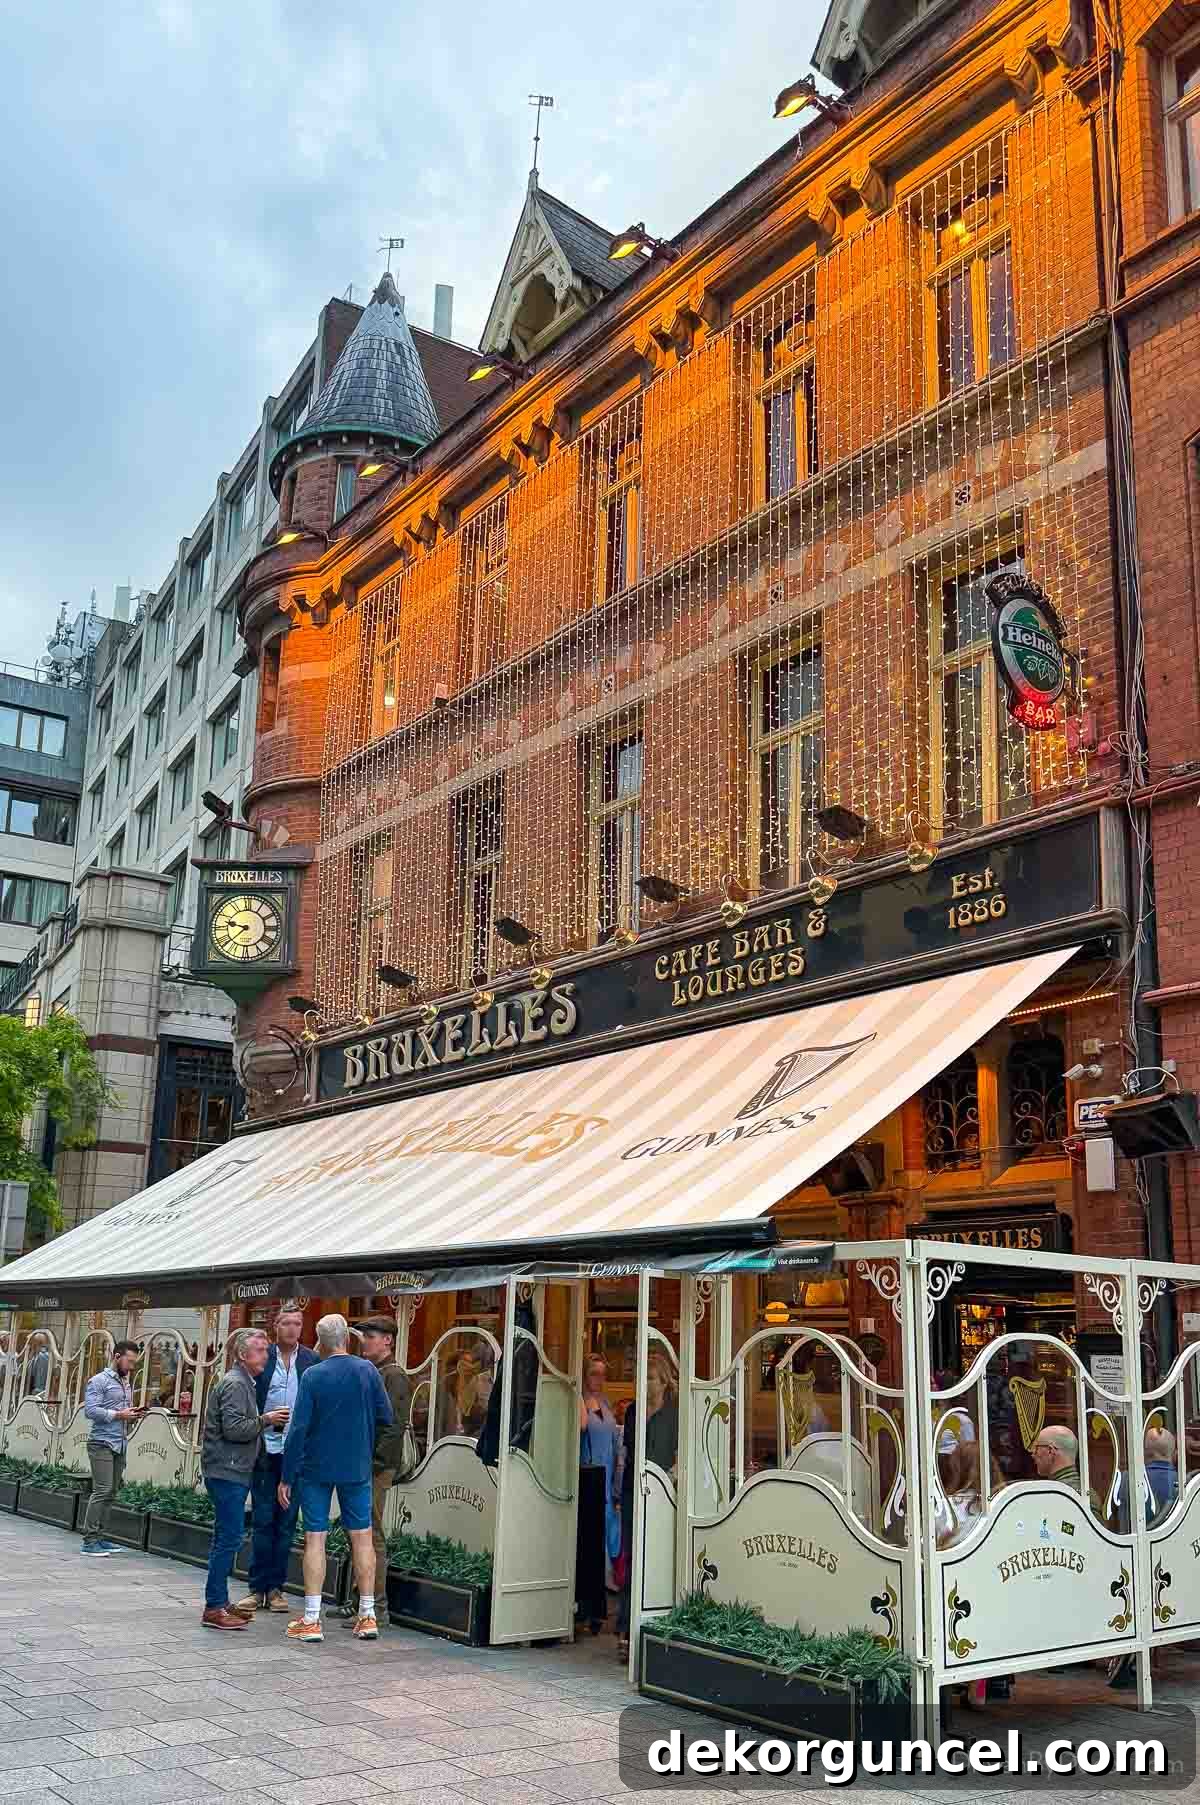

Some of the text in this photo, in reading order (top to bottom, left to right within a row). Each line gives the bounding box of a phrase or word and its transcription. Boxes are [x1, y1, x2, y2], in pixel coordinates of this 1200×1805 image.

[1024, 700, 1056, 724] BAR
[215, 870, 283, 883] BRUXELLES
[951, 866, 1000, 899] Est.
[948, 893, 1007, 928] 1886
[655, 908, 829, 981] CAFE BAR &
[671, 947, 807, 1007] LOUNGES
[343, 982, 577, 1089] BRUXELLES
[620, 1105, 832, 1160] GUINNESS
[237, 1284, 270, 1298] GUINNESS
[427, 1484, 487, 1513] BRUXELLES
[742, 1534, 839, 1575] BRUXELLES
[997, 1546, 1086, 1583] BRUXELLES
